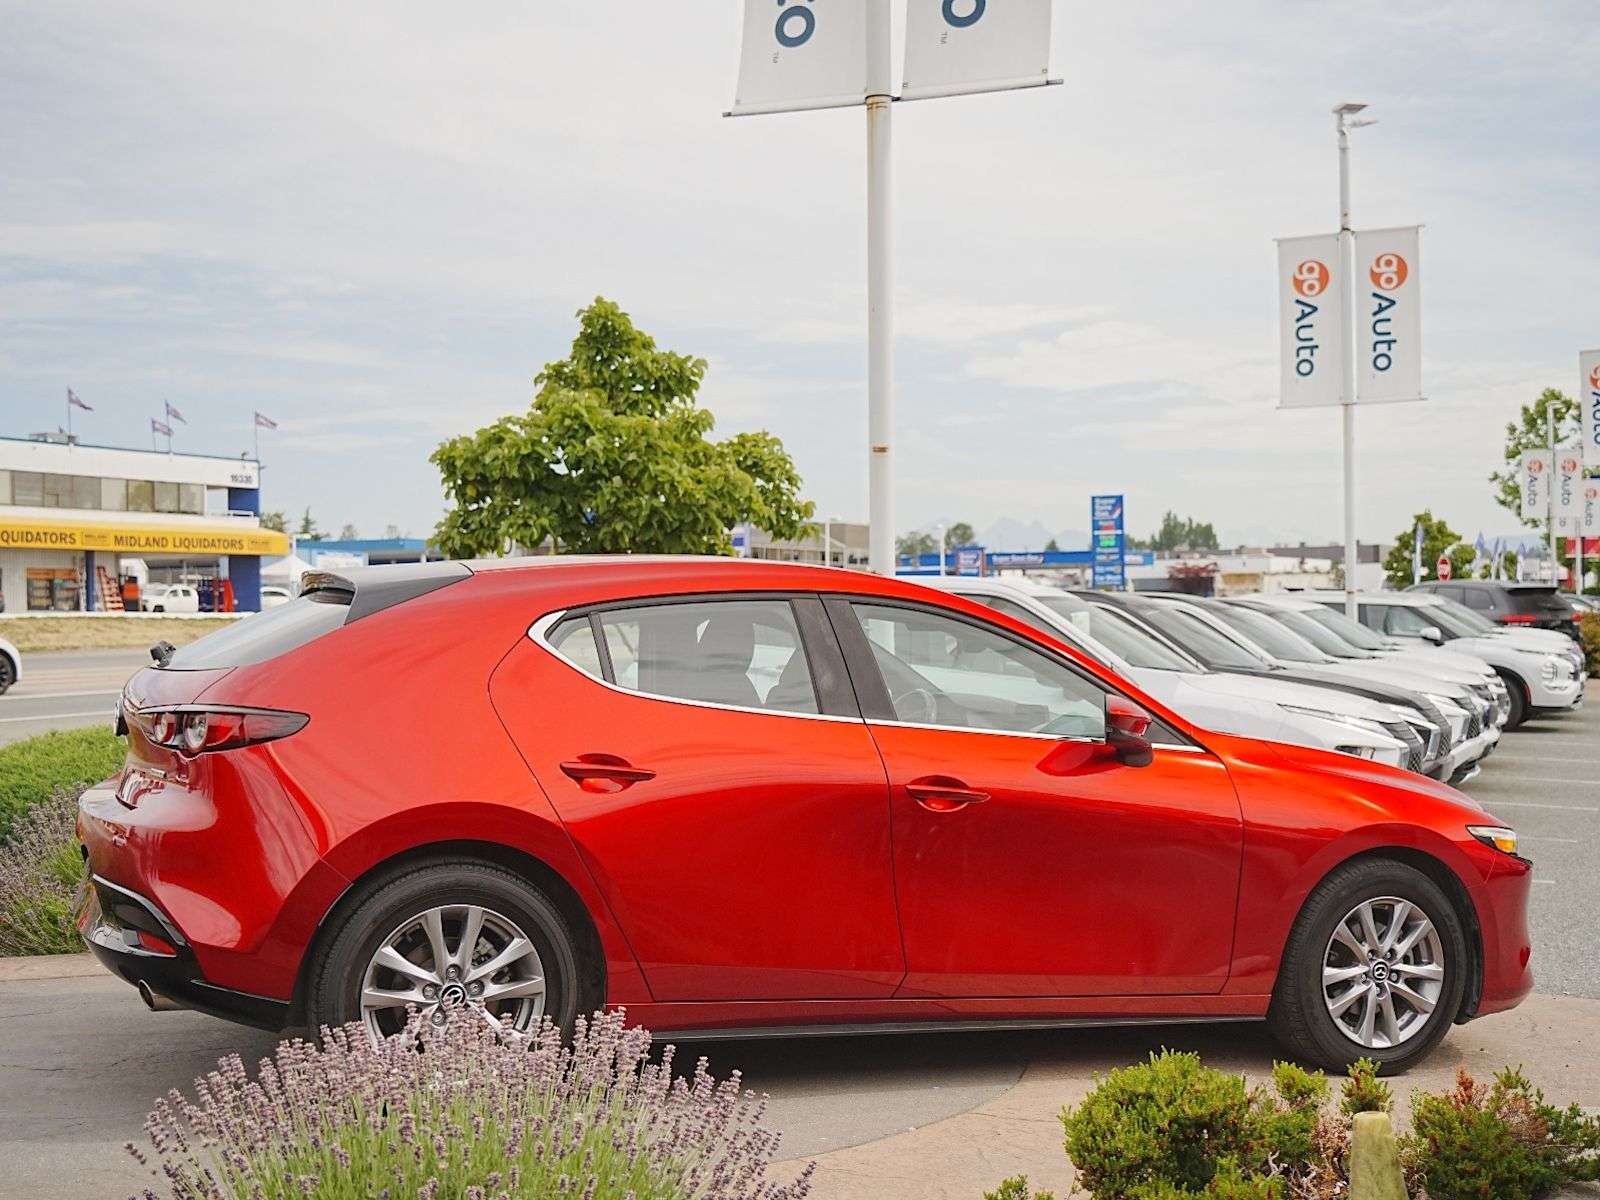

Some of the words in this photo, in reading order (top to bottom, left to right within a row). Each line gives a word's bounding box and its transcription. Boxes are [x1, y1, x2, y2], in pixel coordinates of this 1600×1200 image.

[1293, 260, 1323, 297] go
[1369, 253, 1400, 290] go
[1295, 299, 1319, 377] Auto
[1371, 292, 1398, 372] Auto
[1562, 473, 1572, 506] Auto
[114, 535, 168, 548] MIDLAND
[173, 537, 244, 551] LIQUIDATORS
